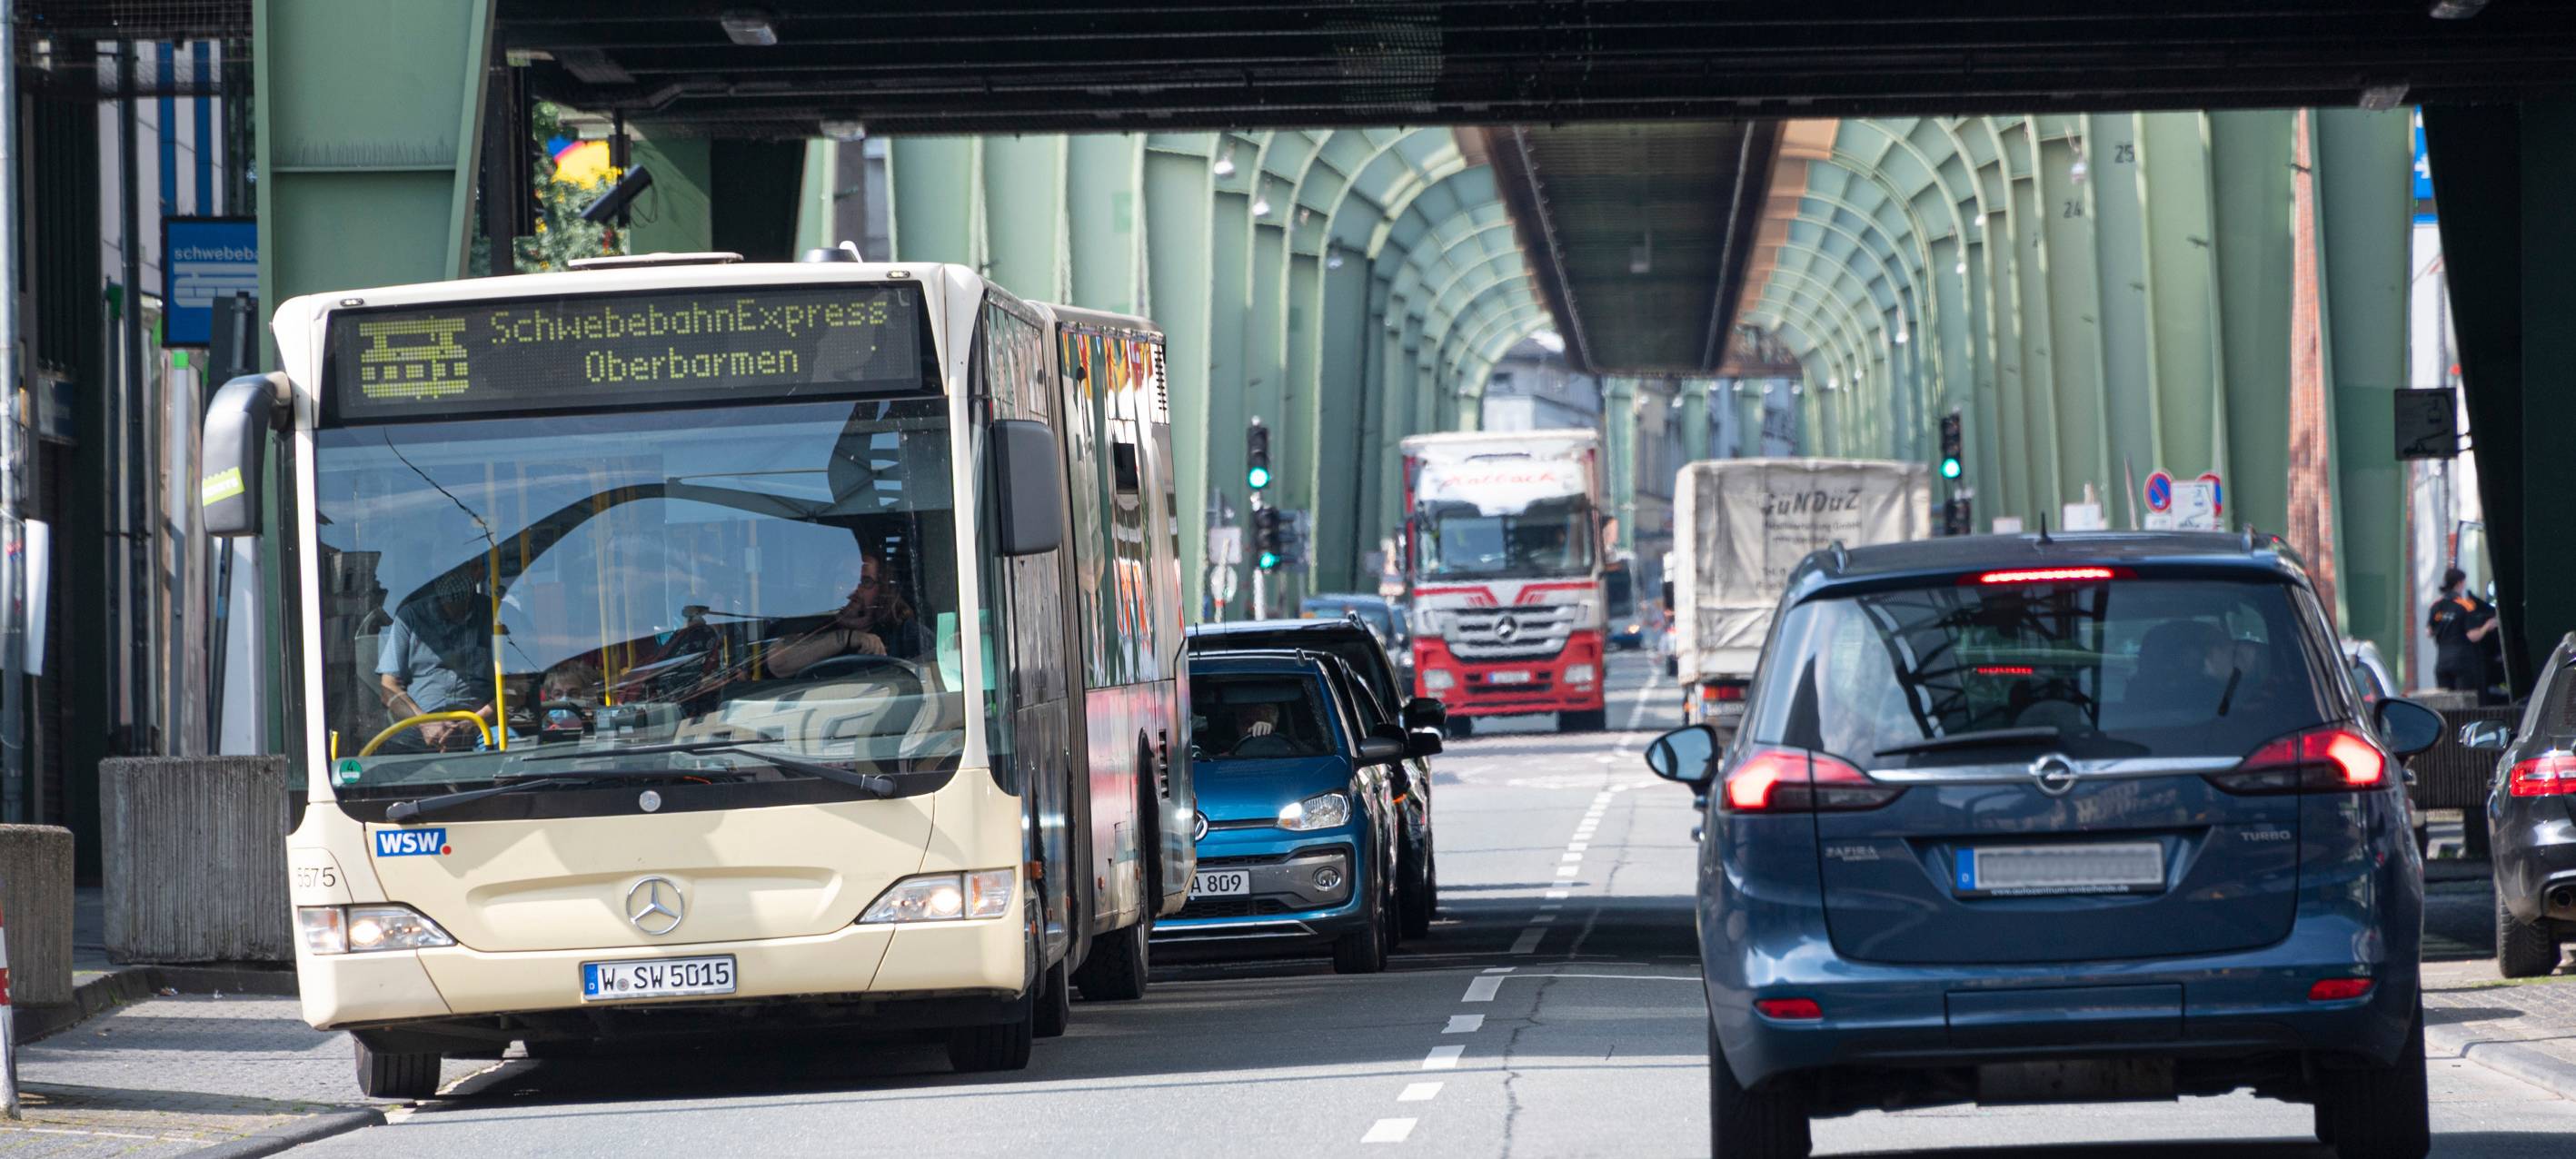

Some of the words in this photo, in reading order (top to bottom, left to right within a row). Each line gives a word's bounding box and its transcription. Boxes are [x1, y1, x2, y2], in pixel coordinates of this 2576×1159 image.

[2114, 144, 2135, 163] 25
[2063, 200, 2083, 219] 24
[490, 298, 889, 344] SchwebebahnExpress
[584, 346, 800, 383] Oberbarmen
[346, 758, 353, 772] 4
[2240, 829, 2292, 841] TURBO
[1208, 875, 1242, 893] 809
[602, 967, 616, 992] W
[633, 965, 664, 989] SW
[670, 962, 730, 987] 5015
